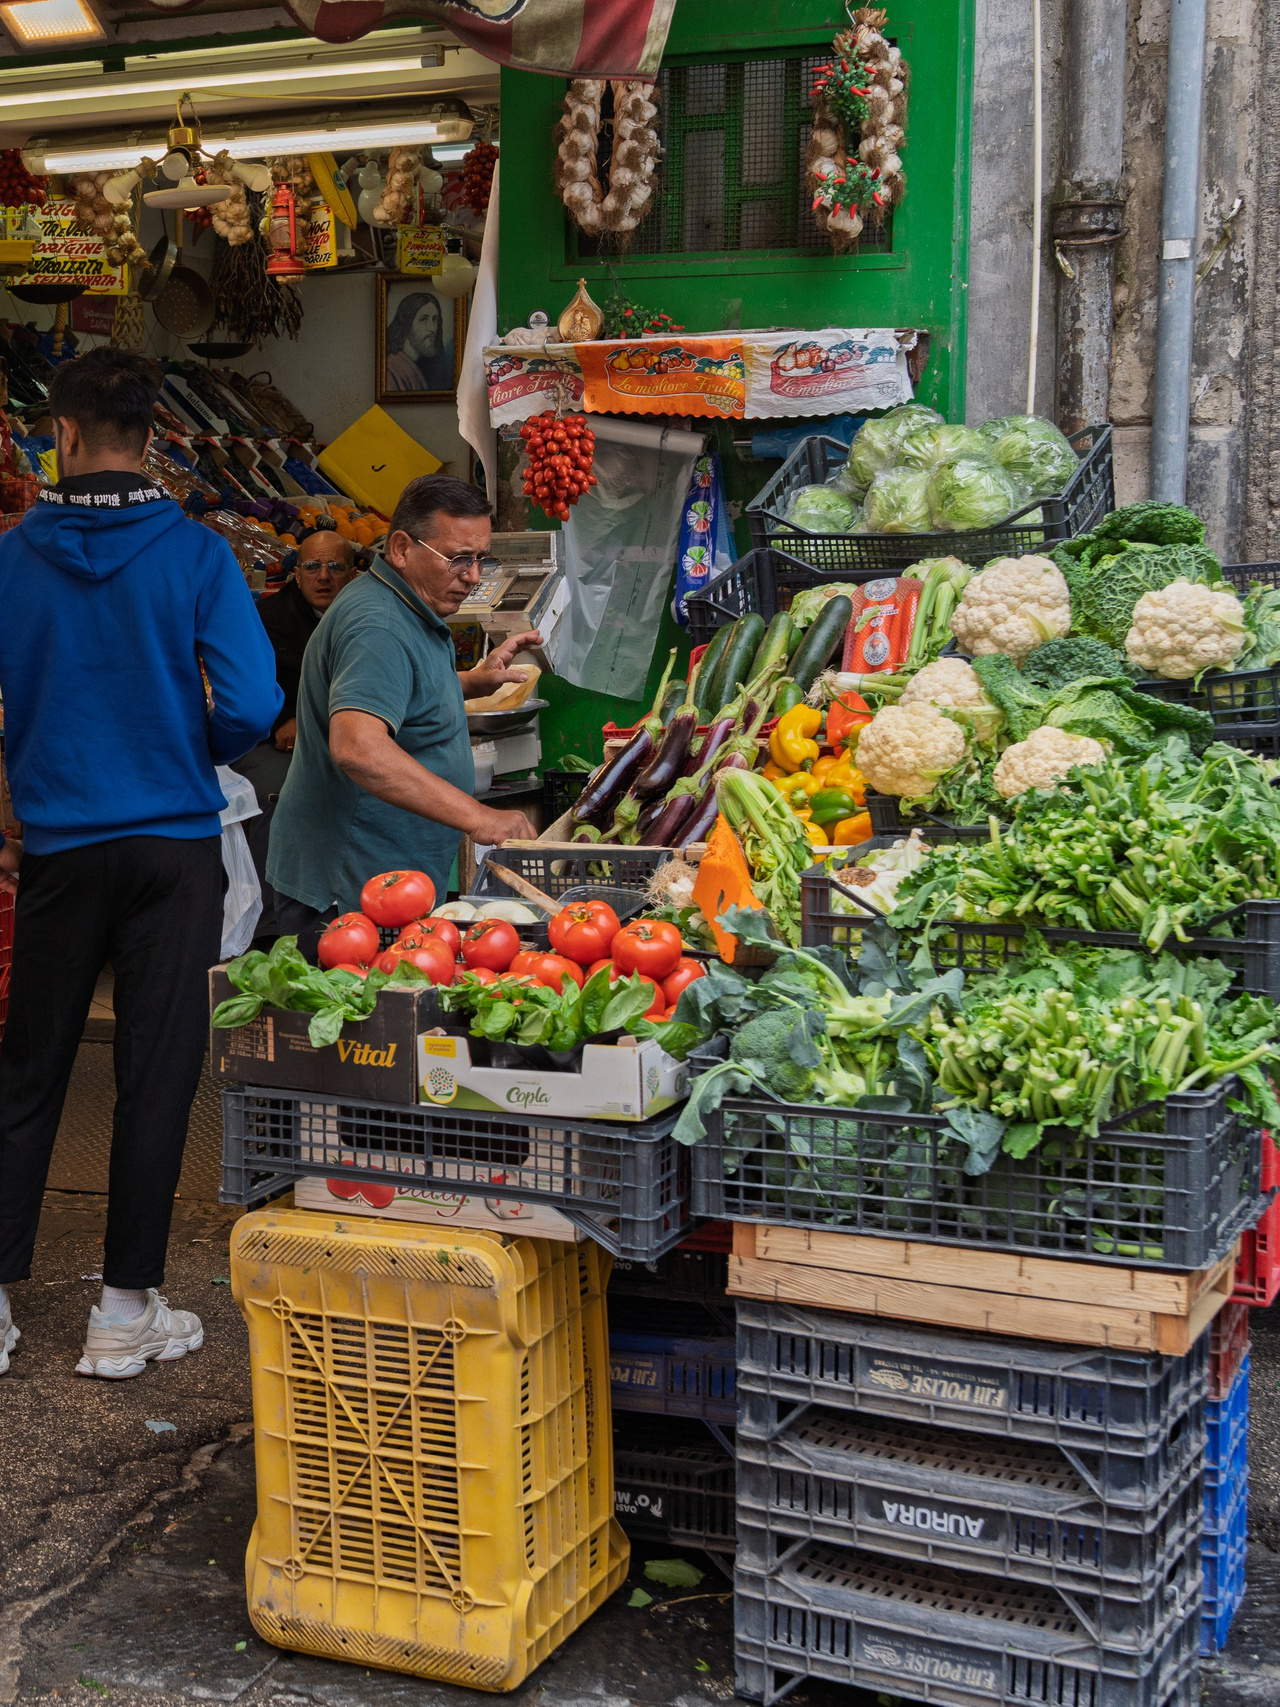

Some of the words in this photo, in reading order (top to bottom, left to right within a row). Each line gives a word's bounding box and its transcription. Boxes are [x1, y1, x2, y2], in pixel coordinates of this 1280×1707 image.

[613, 372, 632, 392] La
[634, 380, 689, 397] migliore
[692, 373, 742, 398] Frutta
[776, 376, 796, 394] La
[796, 375, 857, 397] migliore
[186, 391, 213, 422] Balsamo
[70, 493, 92, 506] Paris
[94, 492, 121, 507] Black
[336, 1038, 397, 1068] Vital
[506, 1087, 551, 1109] Copla
[910, 1374, 971, 1400] POLISE
[616, 1503, 637, 1514] OASI
[882, 1500, 985, 1539] AURORA
[903, 1651, 963, 1681] POLISE
